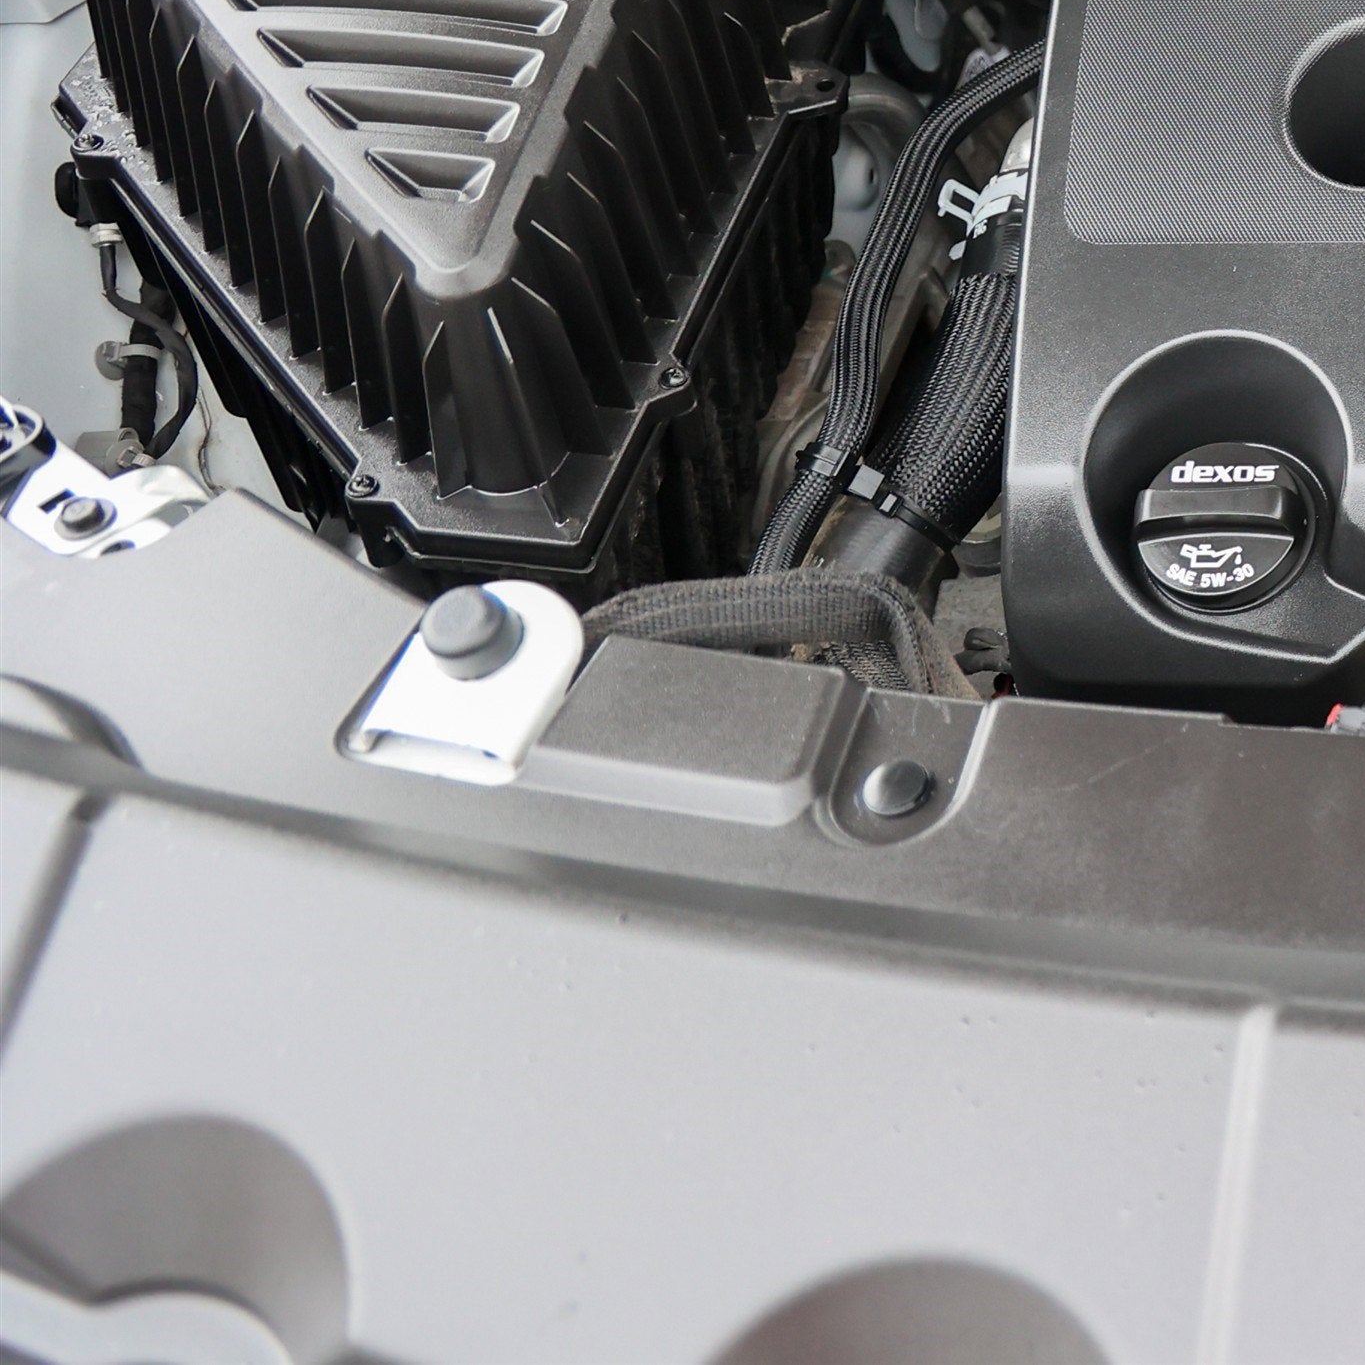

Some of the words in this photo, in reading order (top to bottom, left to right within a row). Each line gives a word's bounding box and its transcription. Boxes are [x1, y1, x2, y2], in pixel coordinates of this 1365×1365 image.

[1171, 460, 1280, 483] dexos
[1166, 563, 1198, 587] SAE
[1200, 563, 1255, 588] 5W-30
